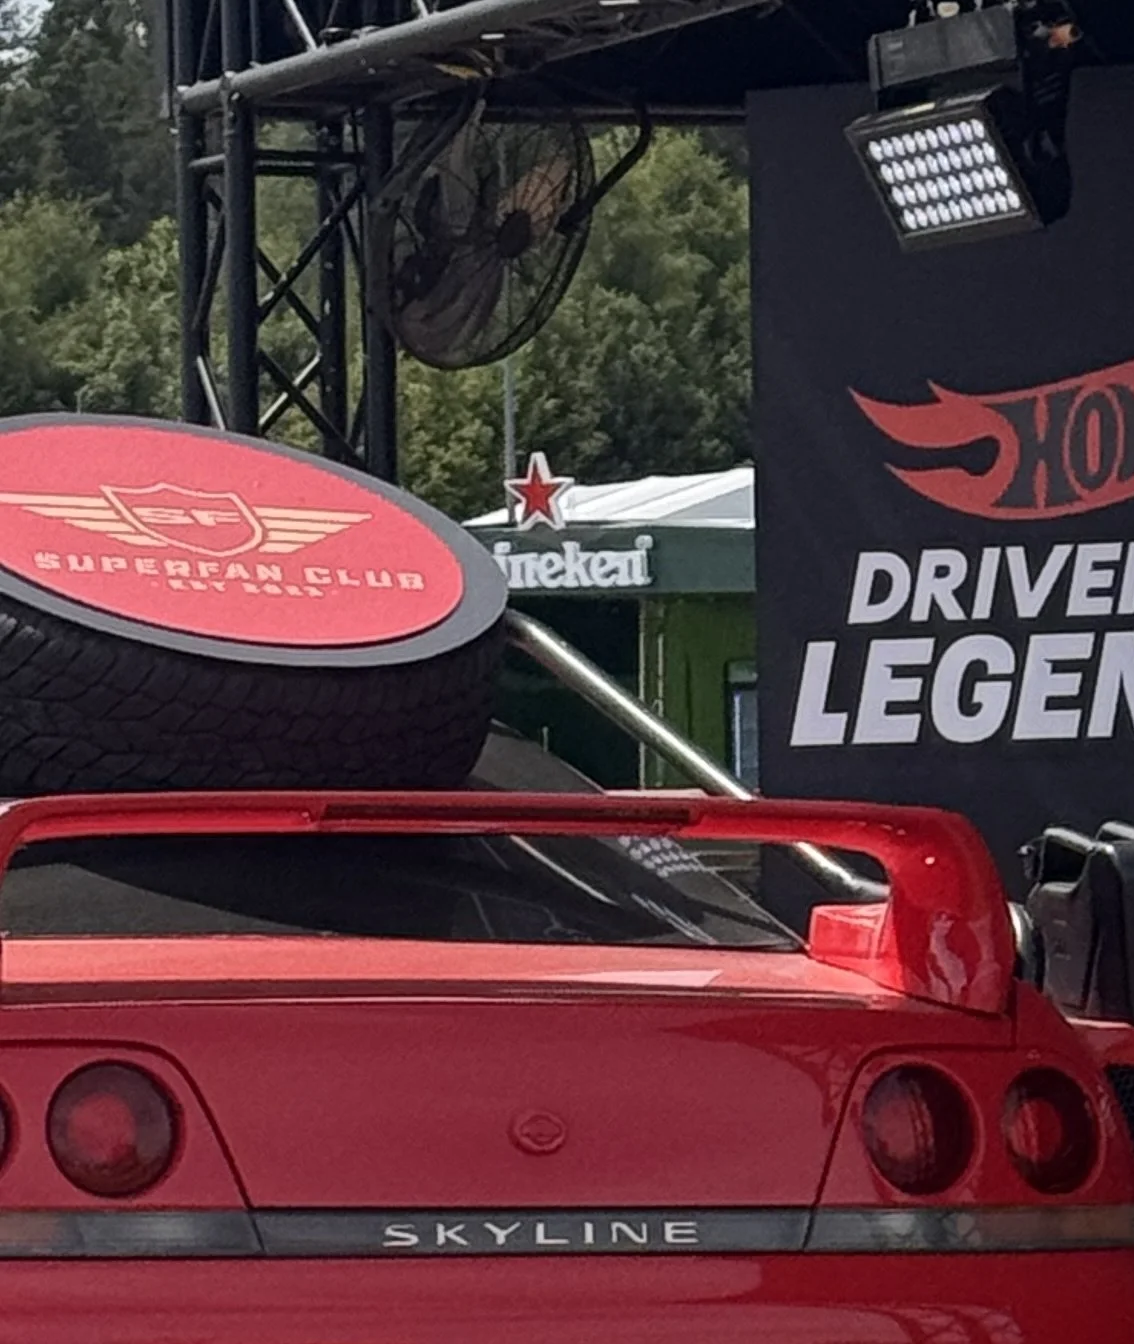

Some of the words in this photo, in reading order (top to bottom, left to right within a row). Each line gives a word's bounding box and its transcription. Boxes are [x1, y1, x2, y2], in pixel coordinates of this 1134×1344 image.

[32, 551, 283, 583] SUPERFAN
[304, 566, 426, 591] CLUB
[486, 535, 654, 588] ineken
[382, 1221, 700, 1247] SKYLINE
